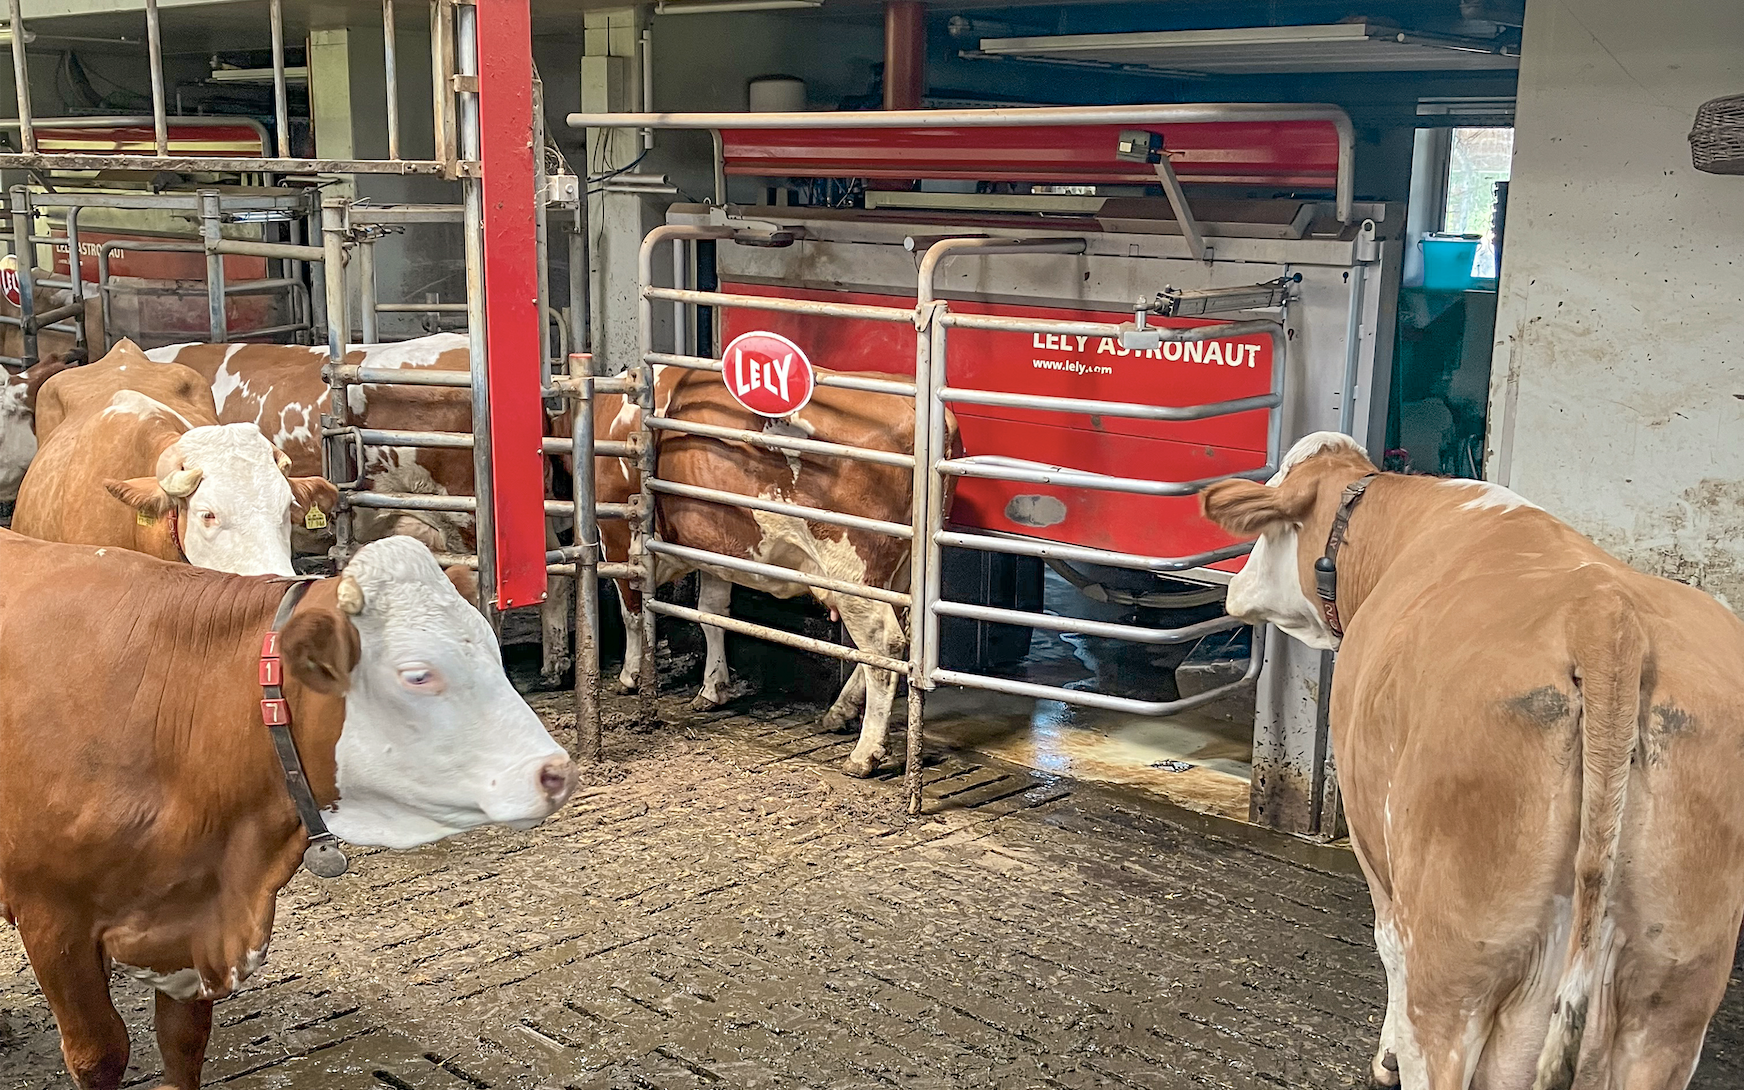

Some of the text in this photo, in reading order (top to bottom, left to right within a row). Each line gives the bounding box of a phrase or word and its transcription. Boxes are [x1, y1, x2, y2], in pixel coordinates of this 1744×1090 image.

[56, 241, 124, 259] LEL ASTROAUT
[2, 268, 21, 296] LEL
[1032, 332, 1088, 353] LELY
[735, 347, 793, 403] LELY
